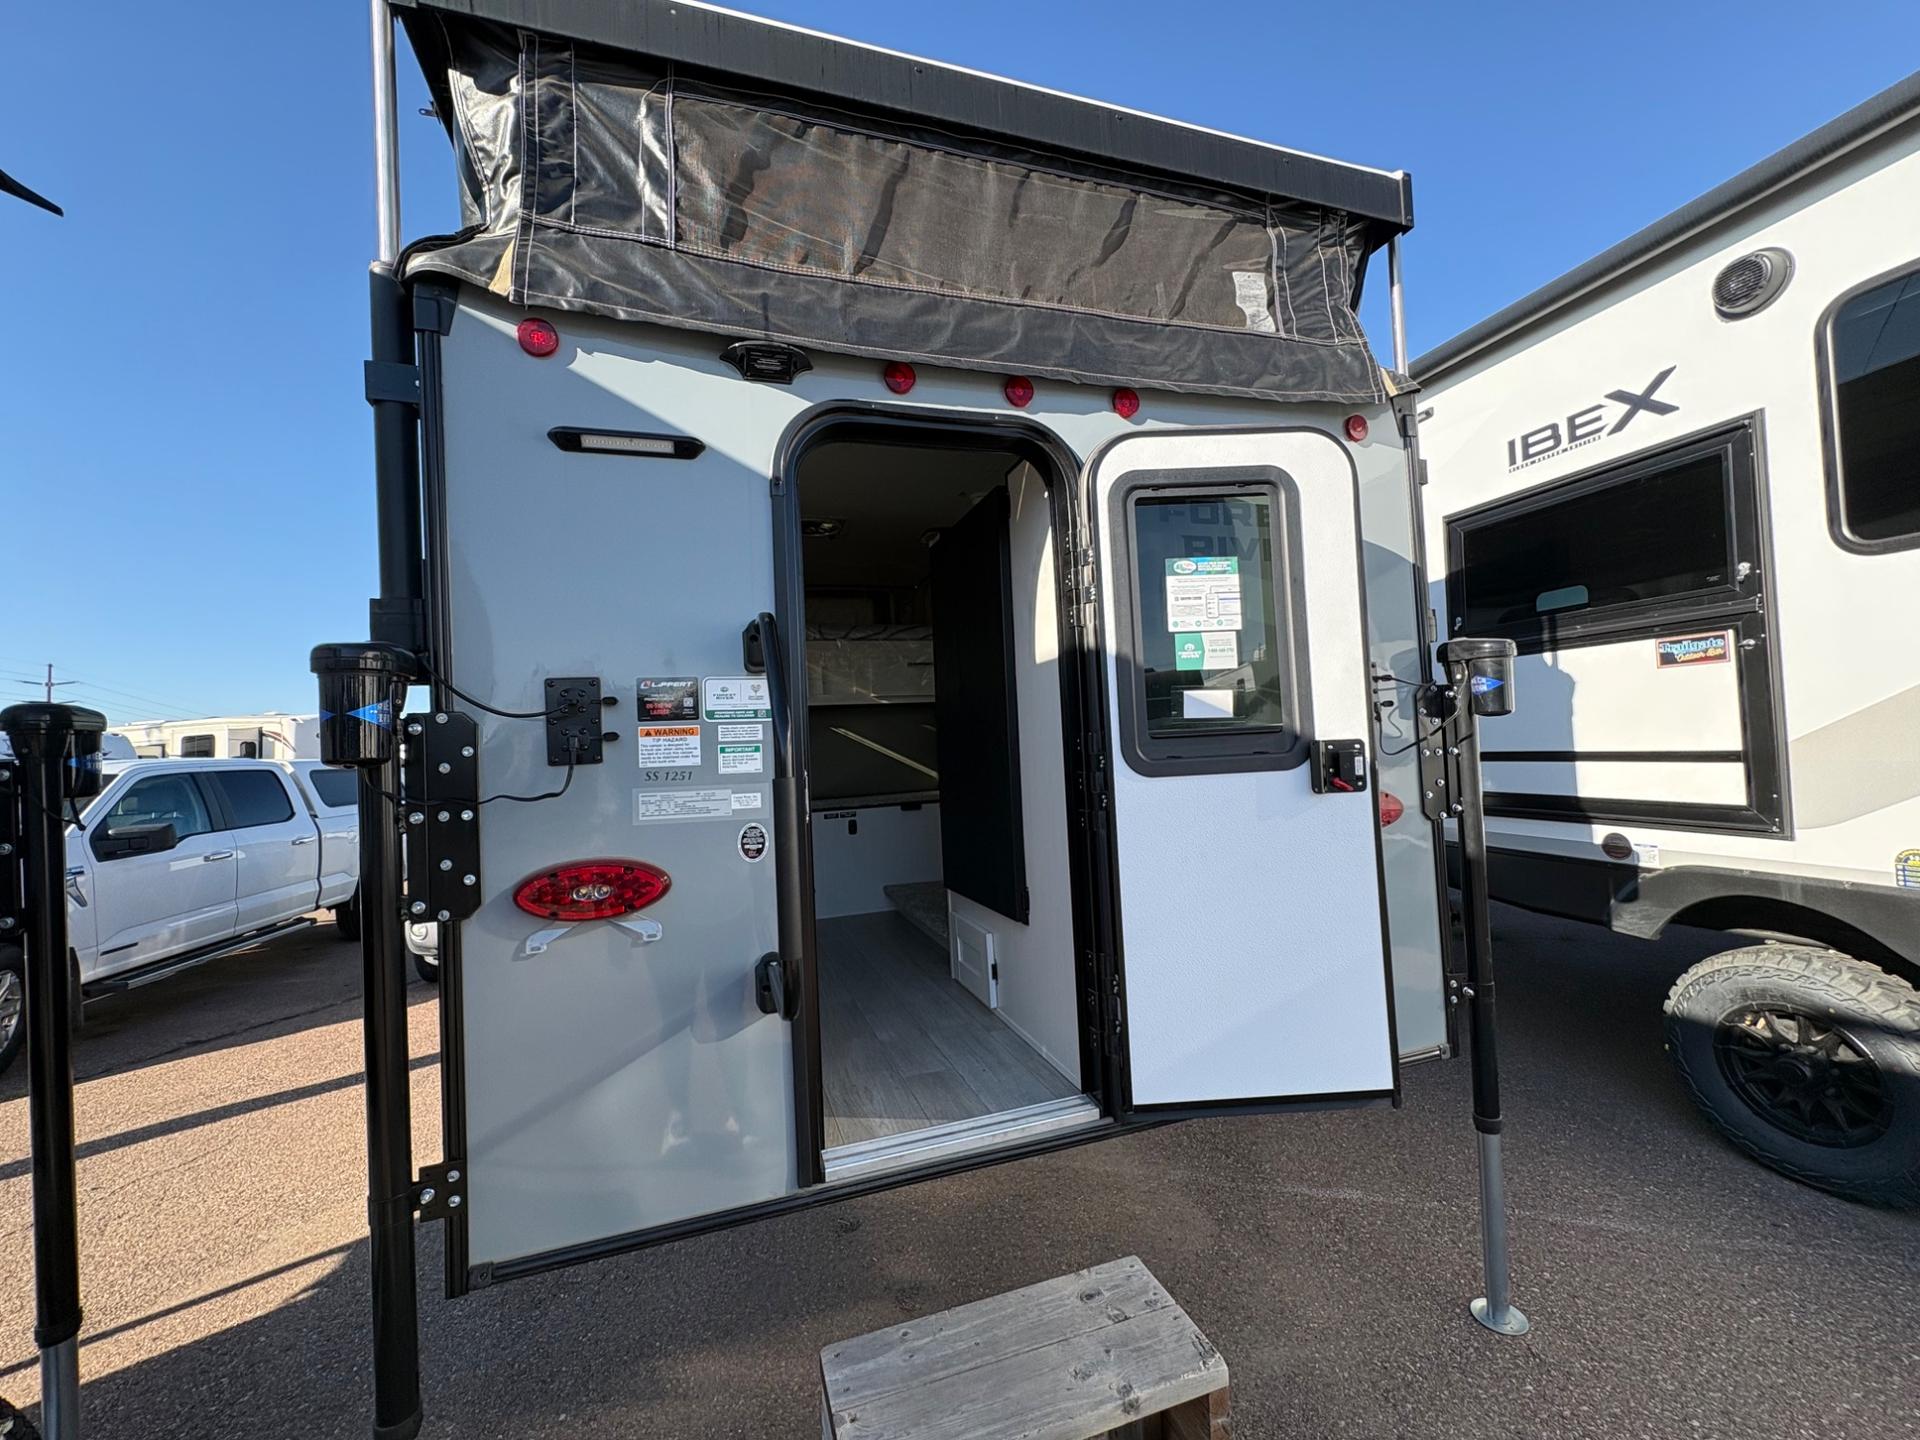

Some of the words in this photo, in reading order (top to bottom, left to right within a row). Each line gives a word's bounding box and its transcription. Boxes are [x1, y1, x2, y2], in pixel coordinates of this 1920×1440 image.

[1508, 365, 1680, 467] IBEX
[654, 728, 695, 736] WARNING
[644, 771, 660, 782] SS
[664, 771, 693, 782] 1251
